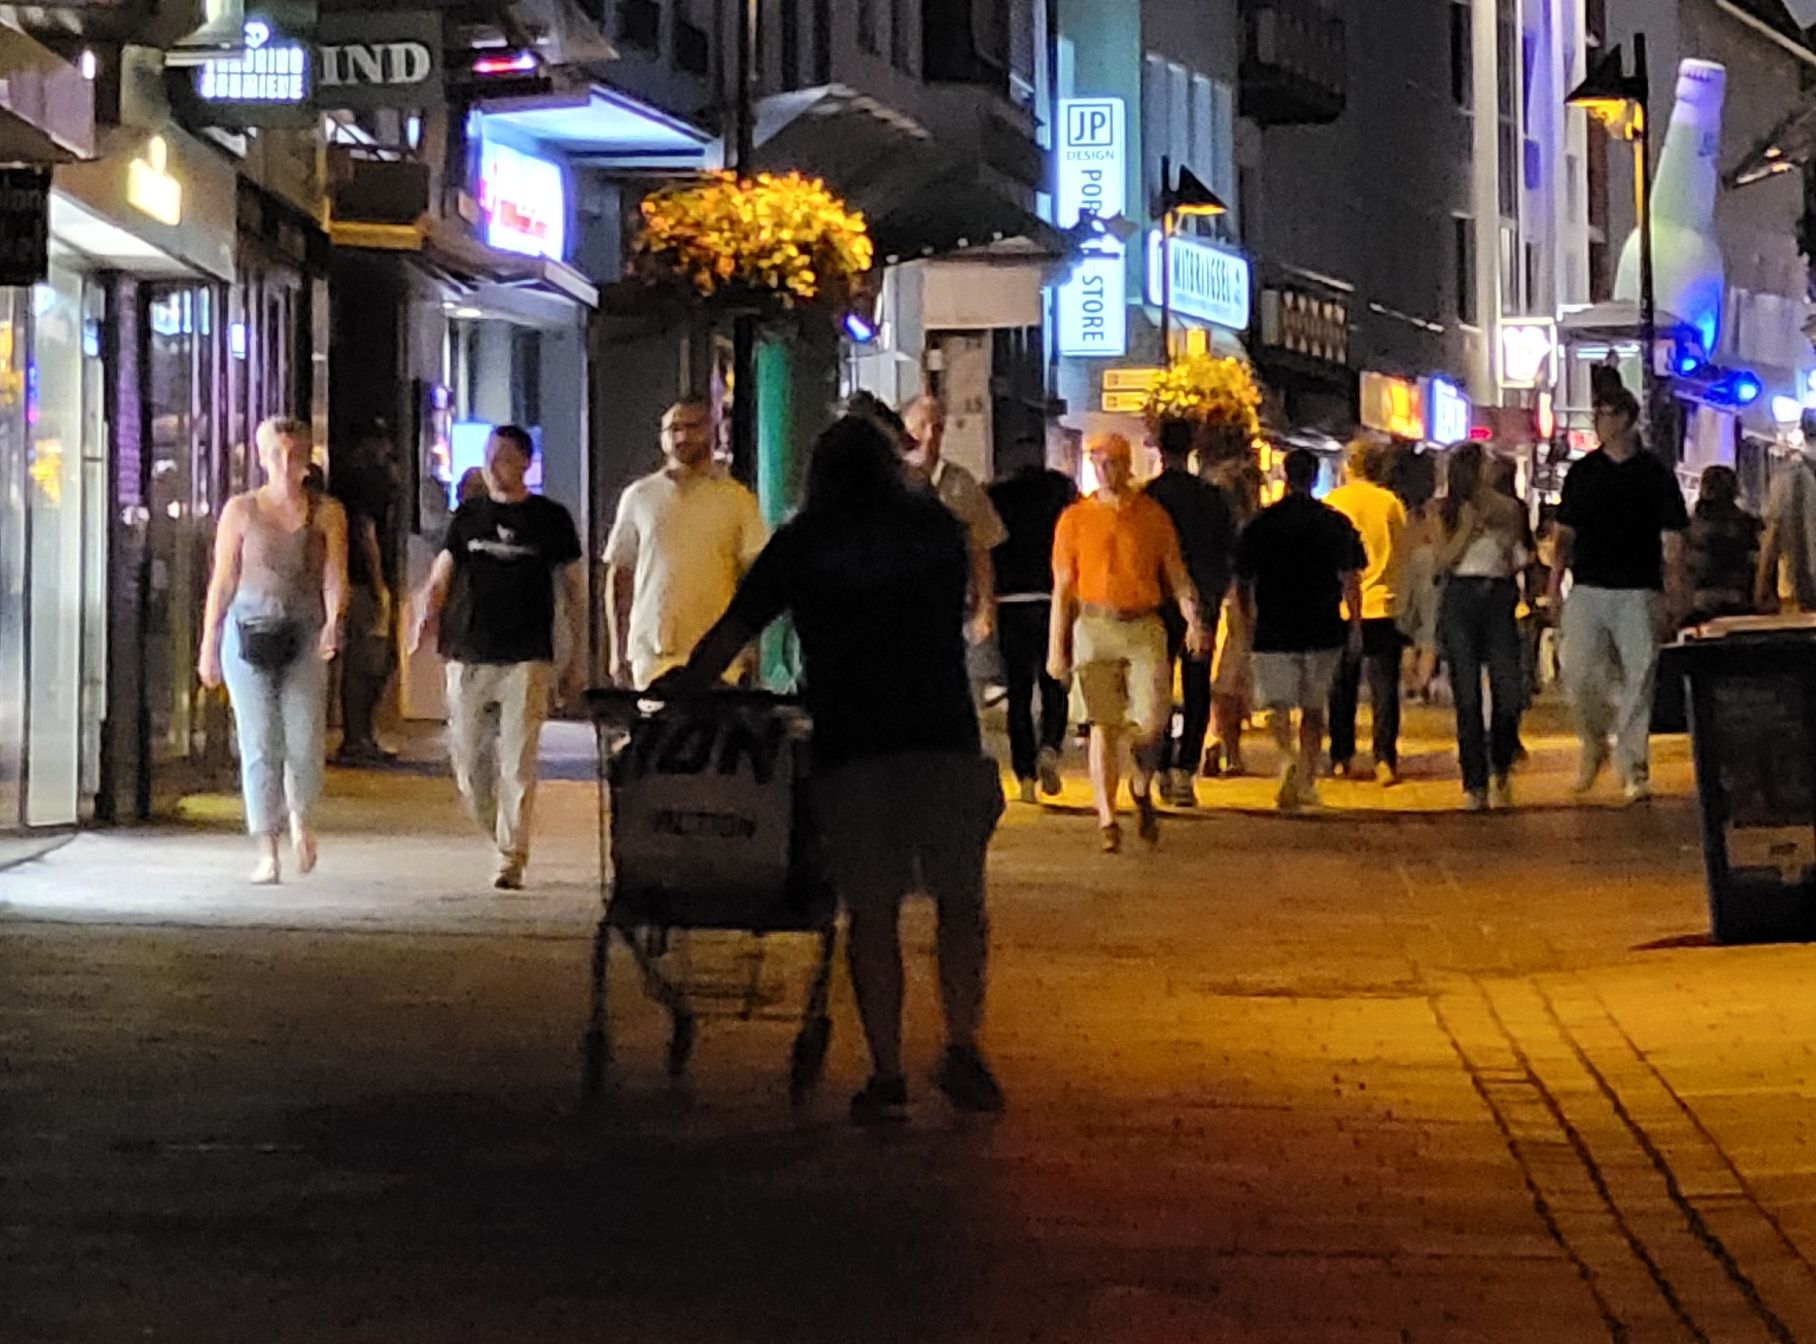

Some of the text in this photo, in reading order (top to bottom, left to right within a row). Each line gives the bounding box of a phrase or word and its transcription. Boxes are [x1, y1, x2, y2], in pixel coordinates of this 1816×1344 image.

[1074, 111, 1106, 141] JP
[1066, 149, 1115, 161] DESIGN
[1082, 274, 1104, 342] STORE
